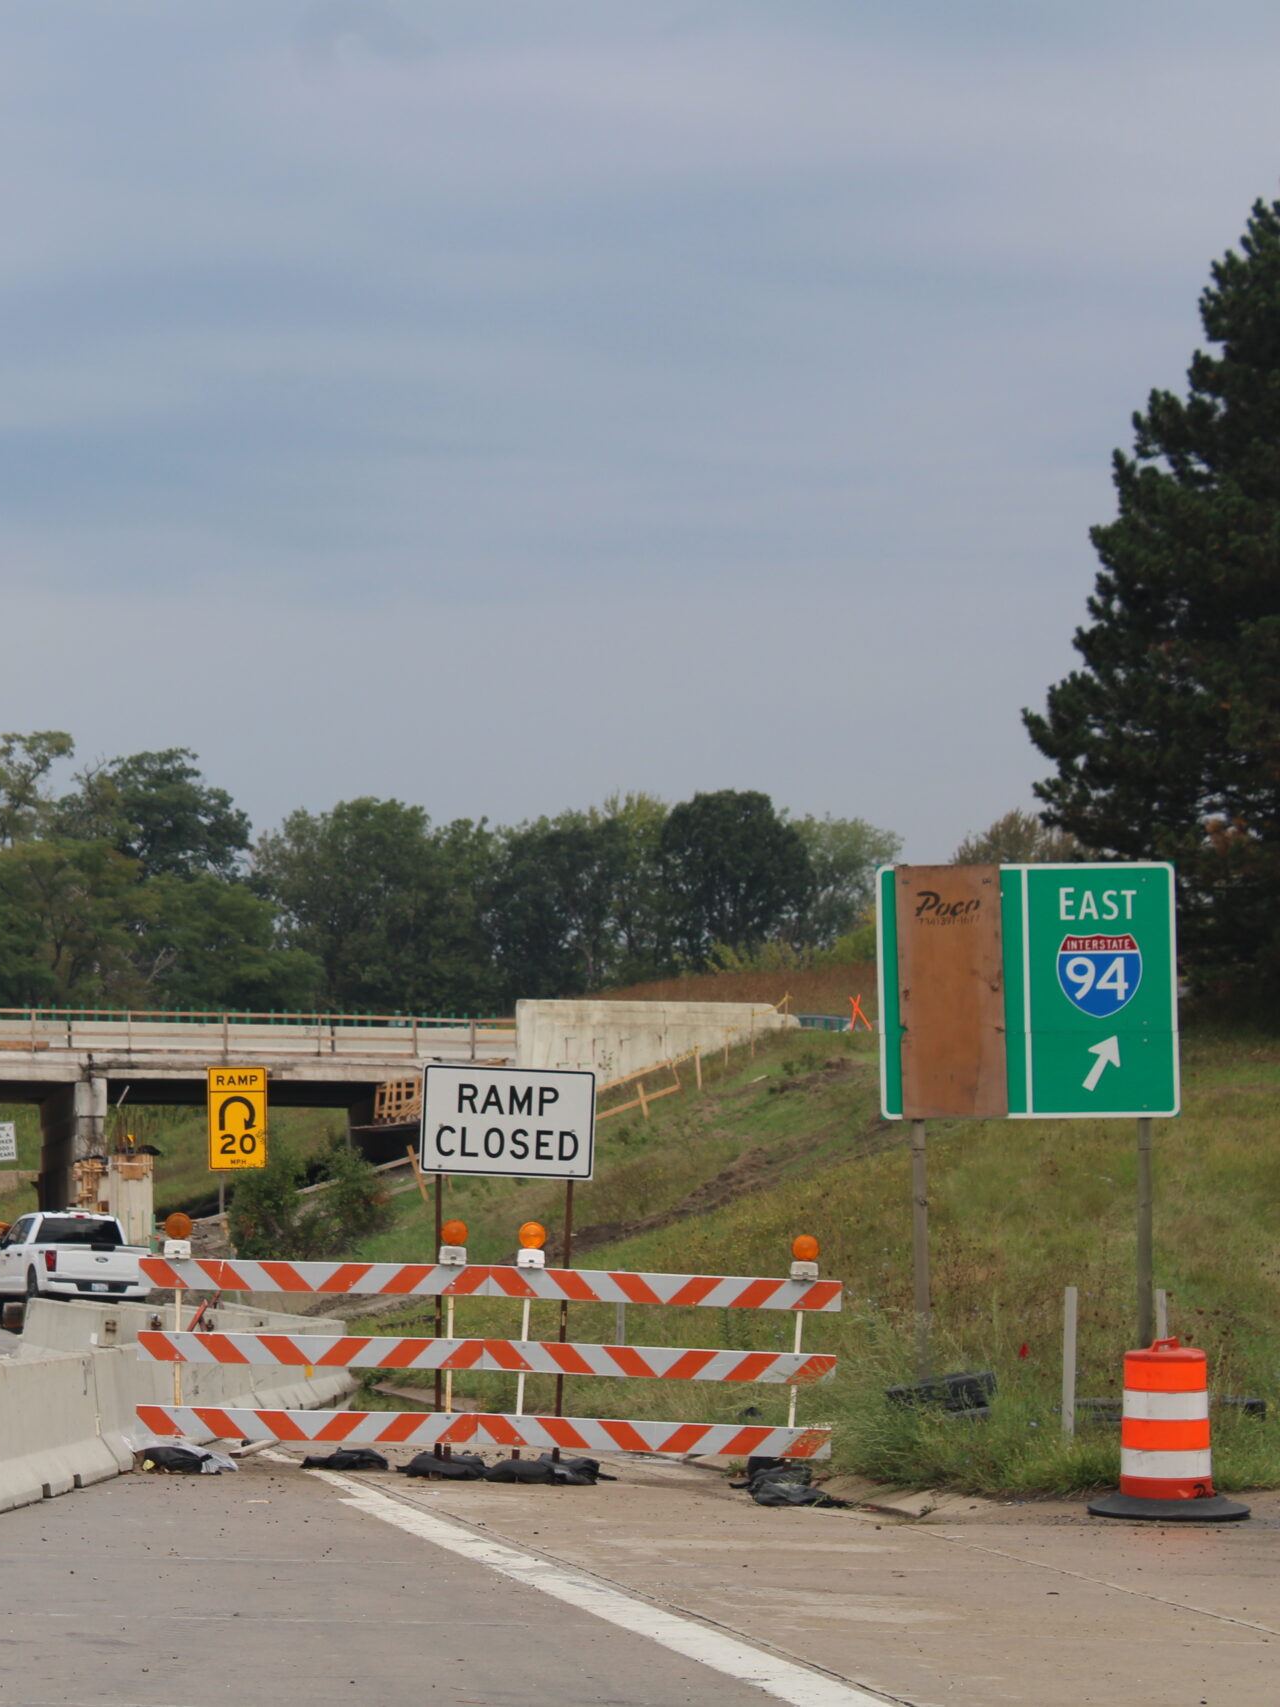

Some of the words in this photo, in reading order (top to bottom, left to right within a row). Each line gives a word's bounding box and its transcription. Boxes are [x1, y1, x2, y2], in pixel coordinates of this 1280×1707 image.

[915, 891, 981, 917] Poco
[1059, 887, 1137, 920] EAST
[1066, 938, 1132, 950] INTERSTATE
[1066, 956, 1129, 1001] 94
[216, 1075, 258, 1086] RAMP
[457, 1083, 560, 1117] RAMP
[220, 1133, 256, 1154] 20
[435, 1125, 579, 1161] CLOSED
